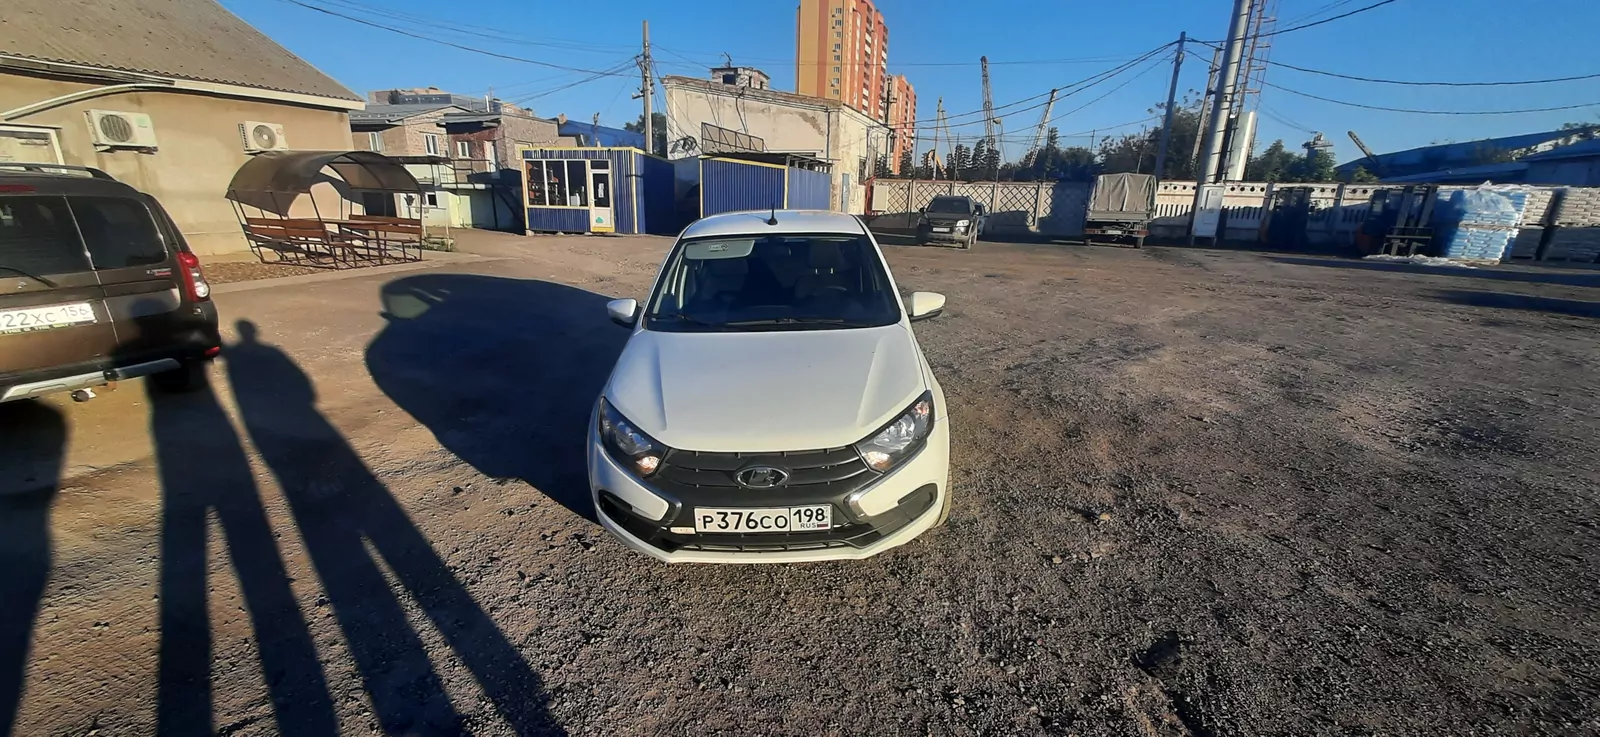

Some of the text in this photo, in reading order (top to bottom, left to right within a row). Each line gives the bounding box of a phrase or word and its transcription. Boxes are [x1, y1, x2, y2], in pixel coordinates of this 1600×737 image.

[0, 306, 87, 328] 22ХС 156
[702, 508, 826, 530] Р376СО 198
